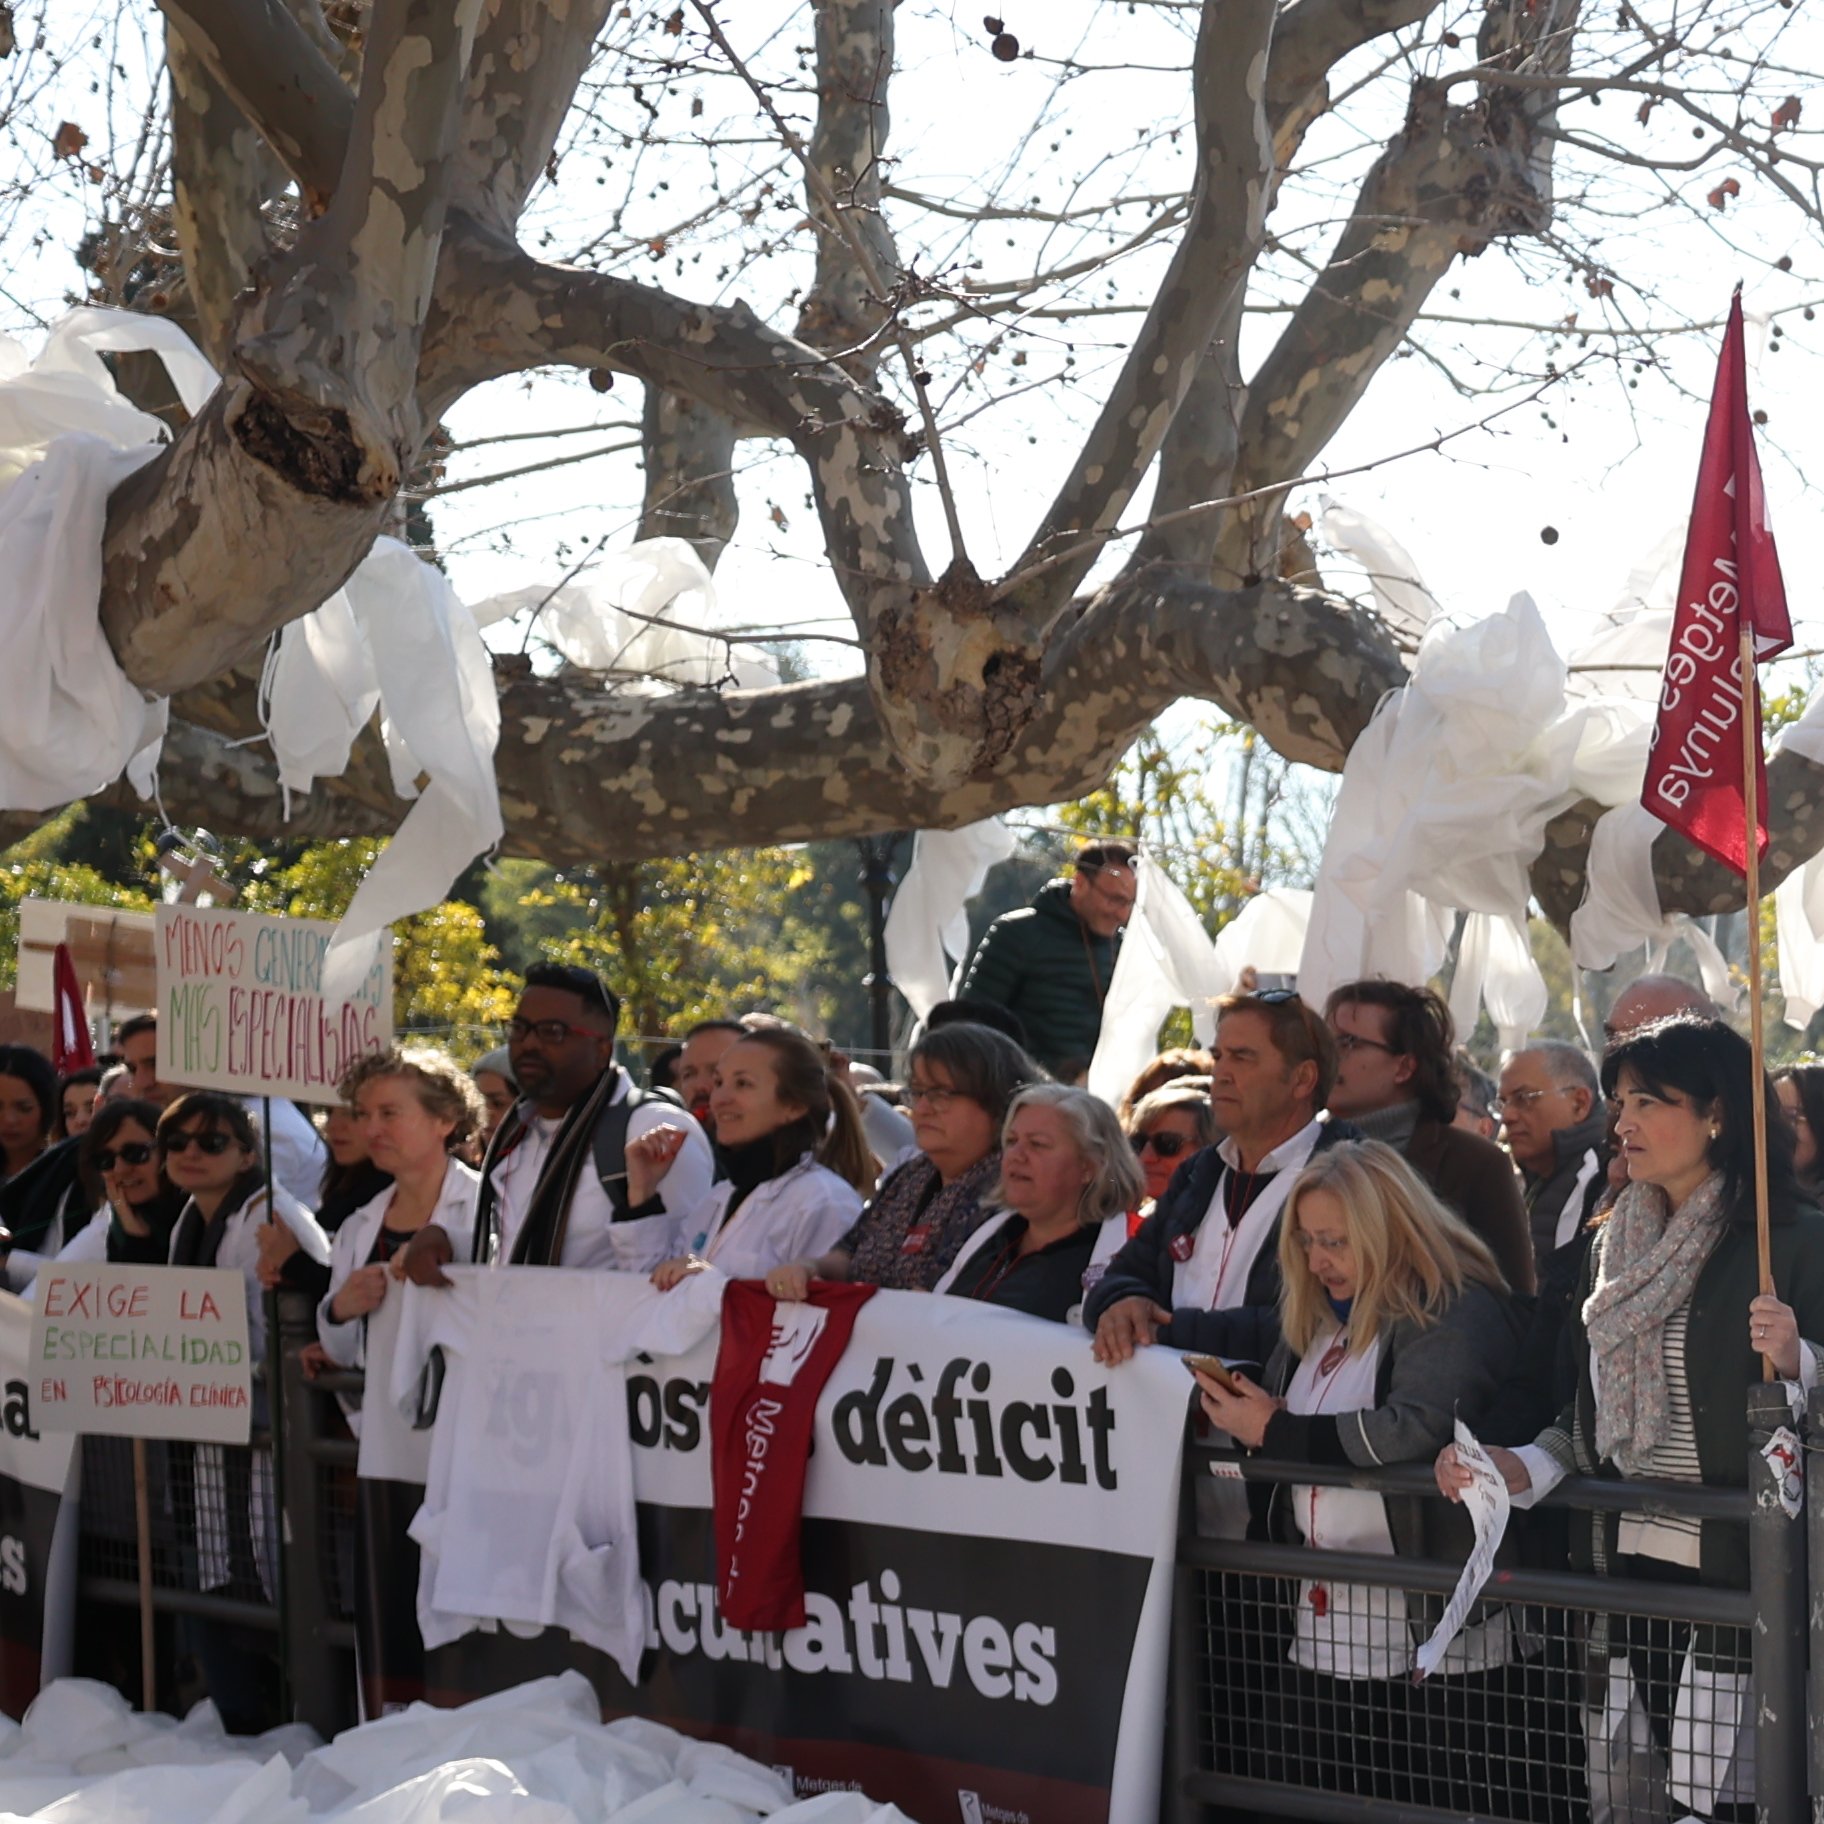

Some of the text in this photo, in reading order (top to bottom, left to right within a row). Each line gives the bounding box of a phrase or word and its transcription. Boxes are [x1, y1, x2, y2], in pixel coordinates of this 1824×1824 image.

[165, 913, 244, 980] MENOS
[44, 1278, 221, 1322] EXIGE LA
[43, 1326, 243, 1366] ESPECIALIDAD
[41, 1377, 67, 1403] EN
[831, 1356, 1118, 1491] dèficit
